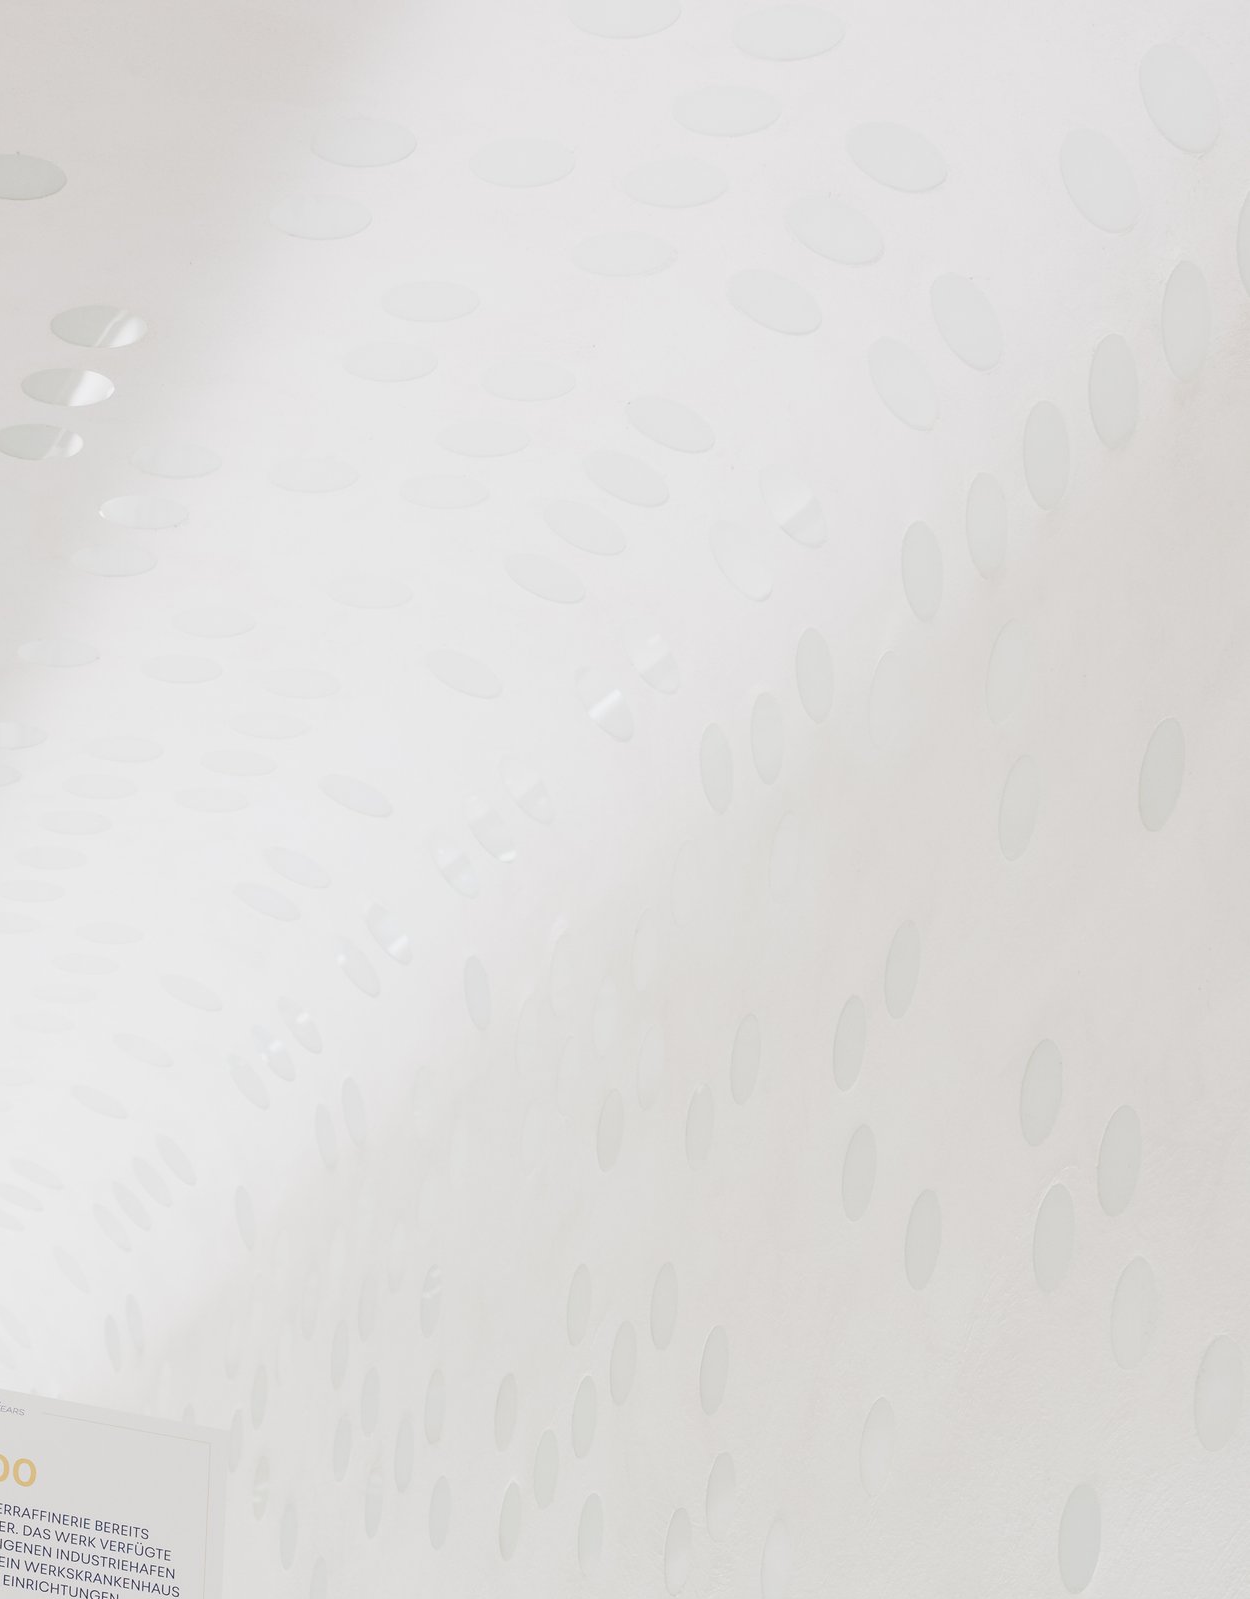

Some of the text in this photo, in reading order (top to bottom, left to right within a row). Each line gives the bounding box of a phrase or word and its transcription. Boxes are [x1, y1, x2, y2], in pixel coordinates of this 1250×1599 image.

[23, 1525, 50, 1540] DAS
[55, 1530, 95, 1548] WERK
[100, 1538, 171, 1561] VERFÜGTE
[95, 1520, 149, 1539] BEREITS
[24, 1561, 179, 1597] WERKSKRANKENHAUS
[57, 1548, 175, 1579] INDUSTRIEHAFEN
